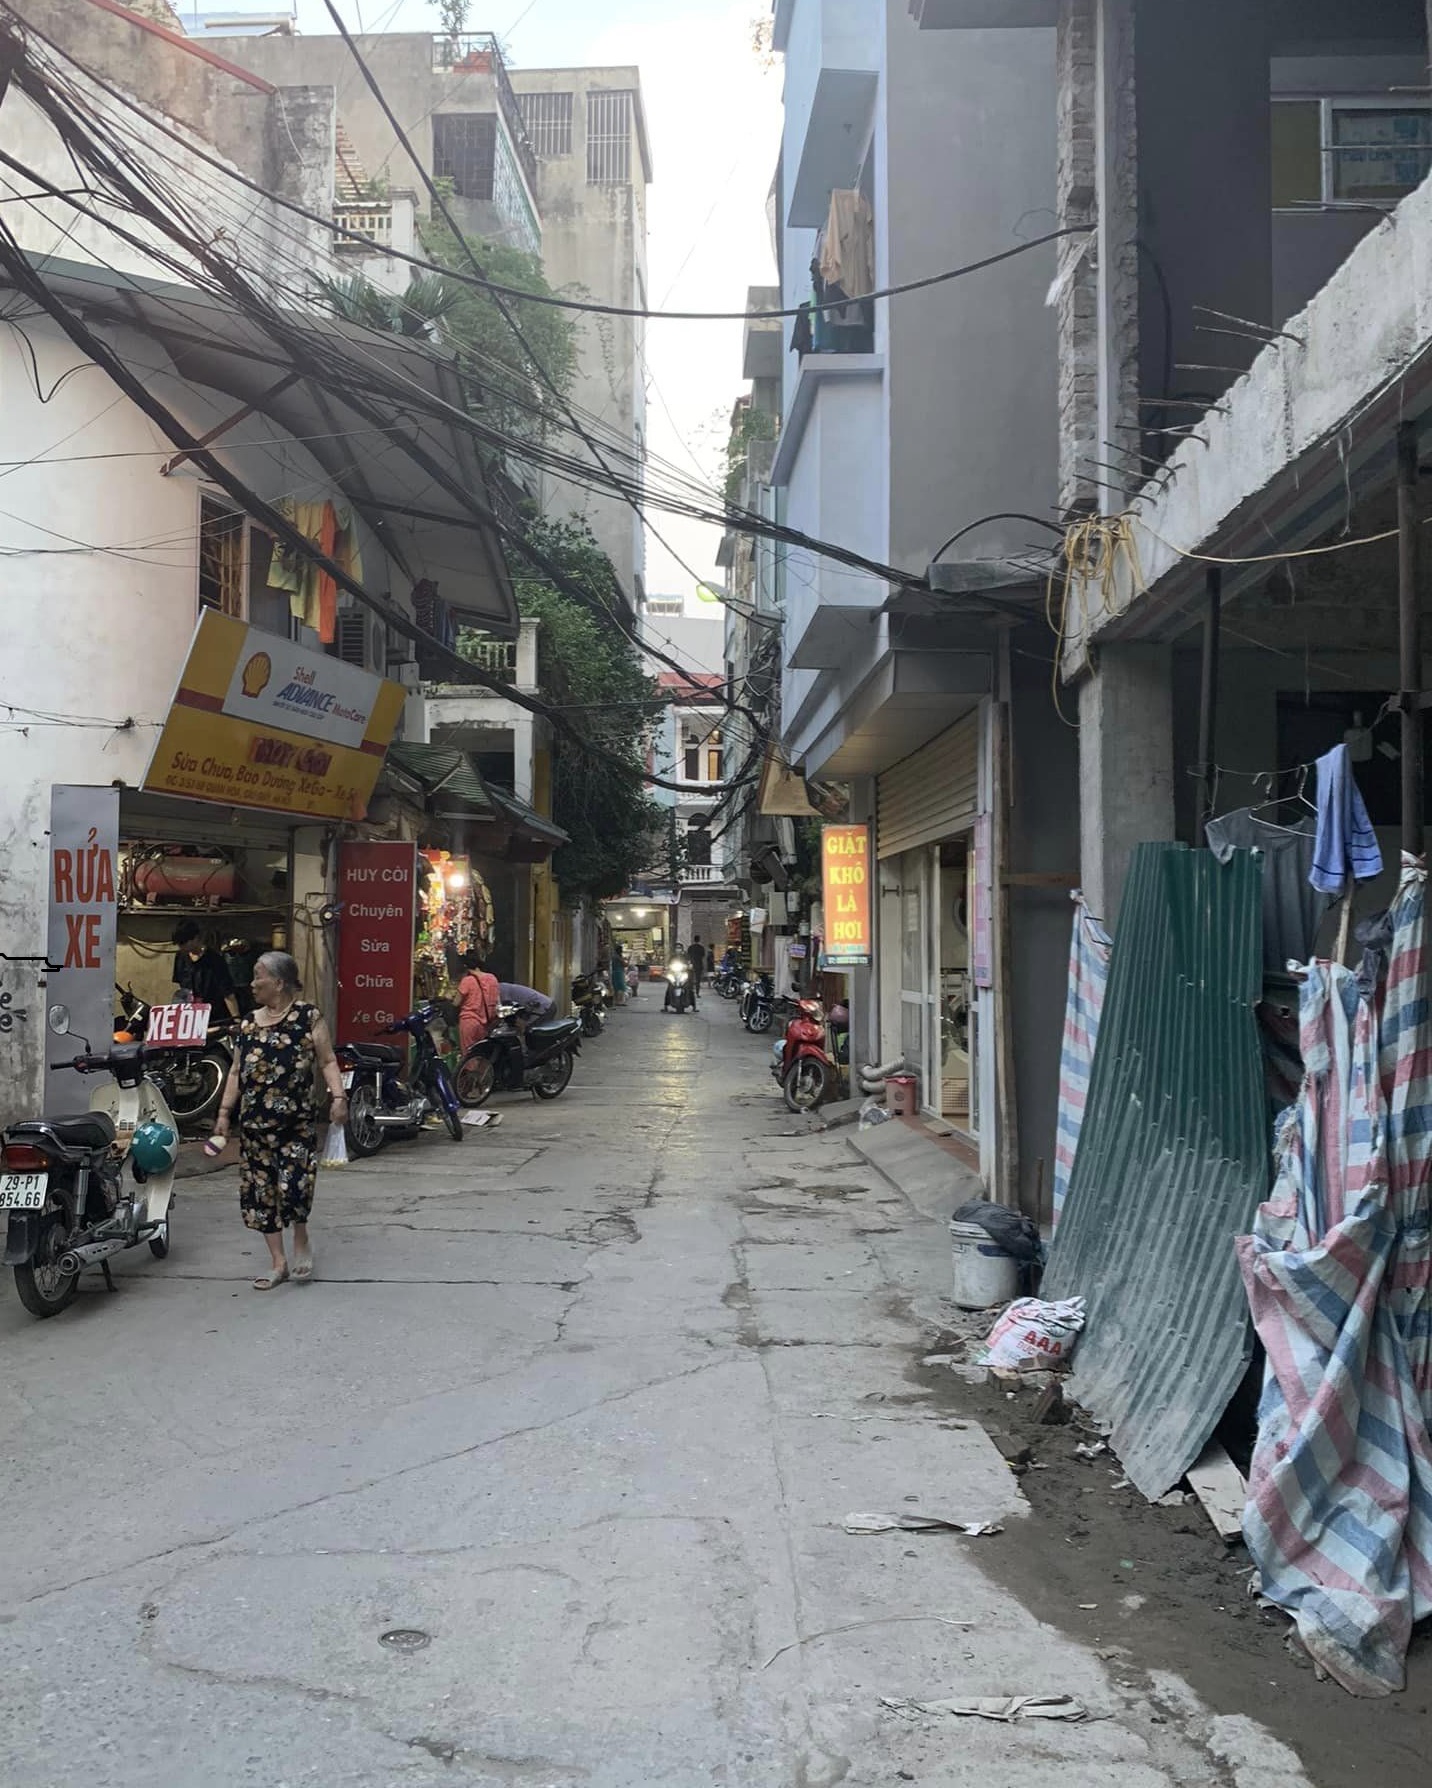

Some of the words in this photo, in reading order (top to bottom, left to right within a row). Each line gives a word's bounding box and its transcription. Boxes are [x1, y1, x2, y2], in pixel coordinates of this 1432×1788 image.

[294, 666, 317, 685] Shell
[276, 683, 336, 713] ADVANCE
[54, 827, 115, 903] RỬA
[347, 868, 378, 883] HUY
[829, 862, 865, 885] KHÔ
[837, 889, 857, 912] LÀ
[350, 903, 403, 920] Chuyên
[64, 914, 102, 968] XE
[355, 973, 394, 988] Chữa
[375, 1010, 394, 1023] Ga
[5, 1175, 39, 1190] 29-P1
[1024, 1330, 1062, 1356] AAA
